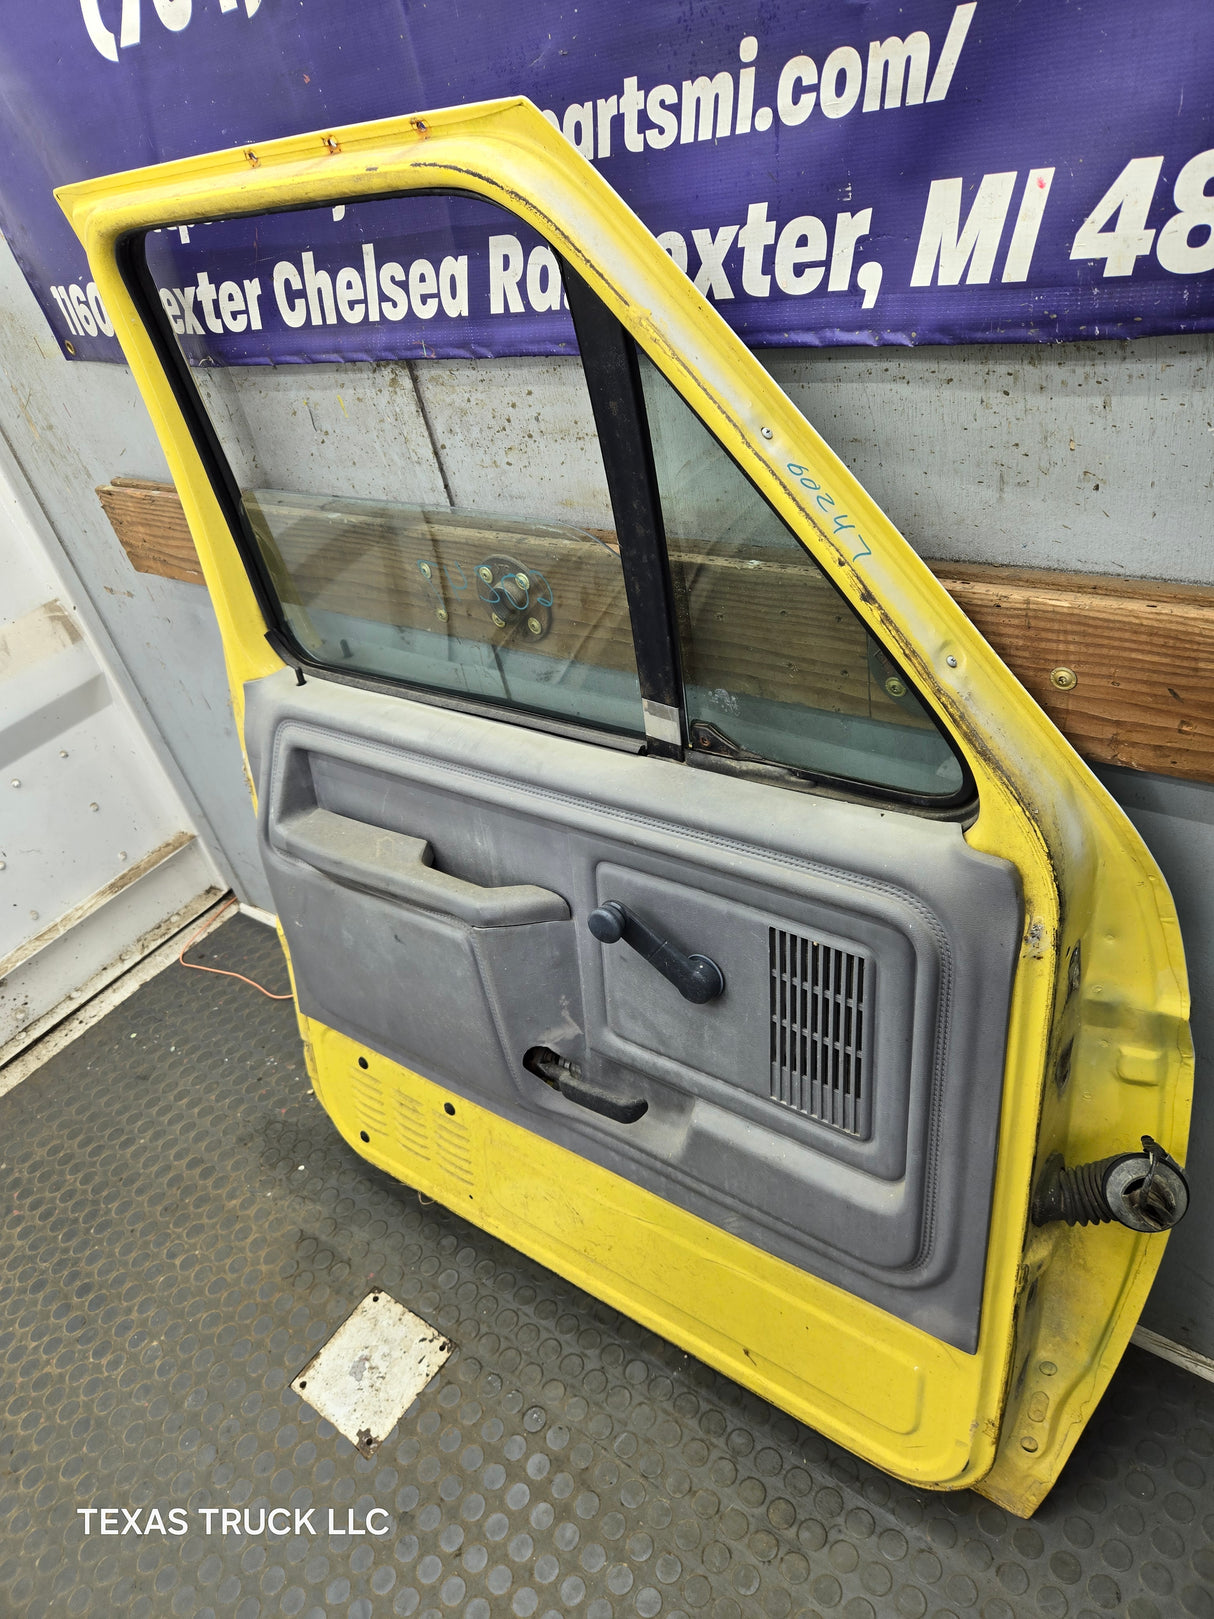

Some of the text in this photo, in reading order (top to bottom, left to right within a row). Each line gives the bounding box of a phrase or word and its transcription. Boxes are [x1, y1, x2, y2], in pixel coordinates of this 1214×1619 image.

[541, 2, 977, 160] artsmi.com/
[159, 271, 263, 335] exter
[273, 243, 468, 328] Chelsea
[489, 234, 571, 314] Ra
[656, 202, 882, 309] xter,
[910, 167, 1056, 287] MI
[787, 463, 872, 562] 60247
